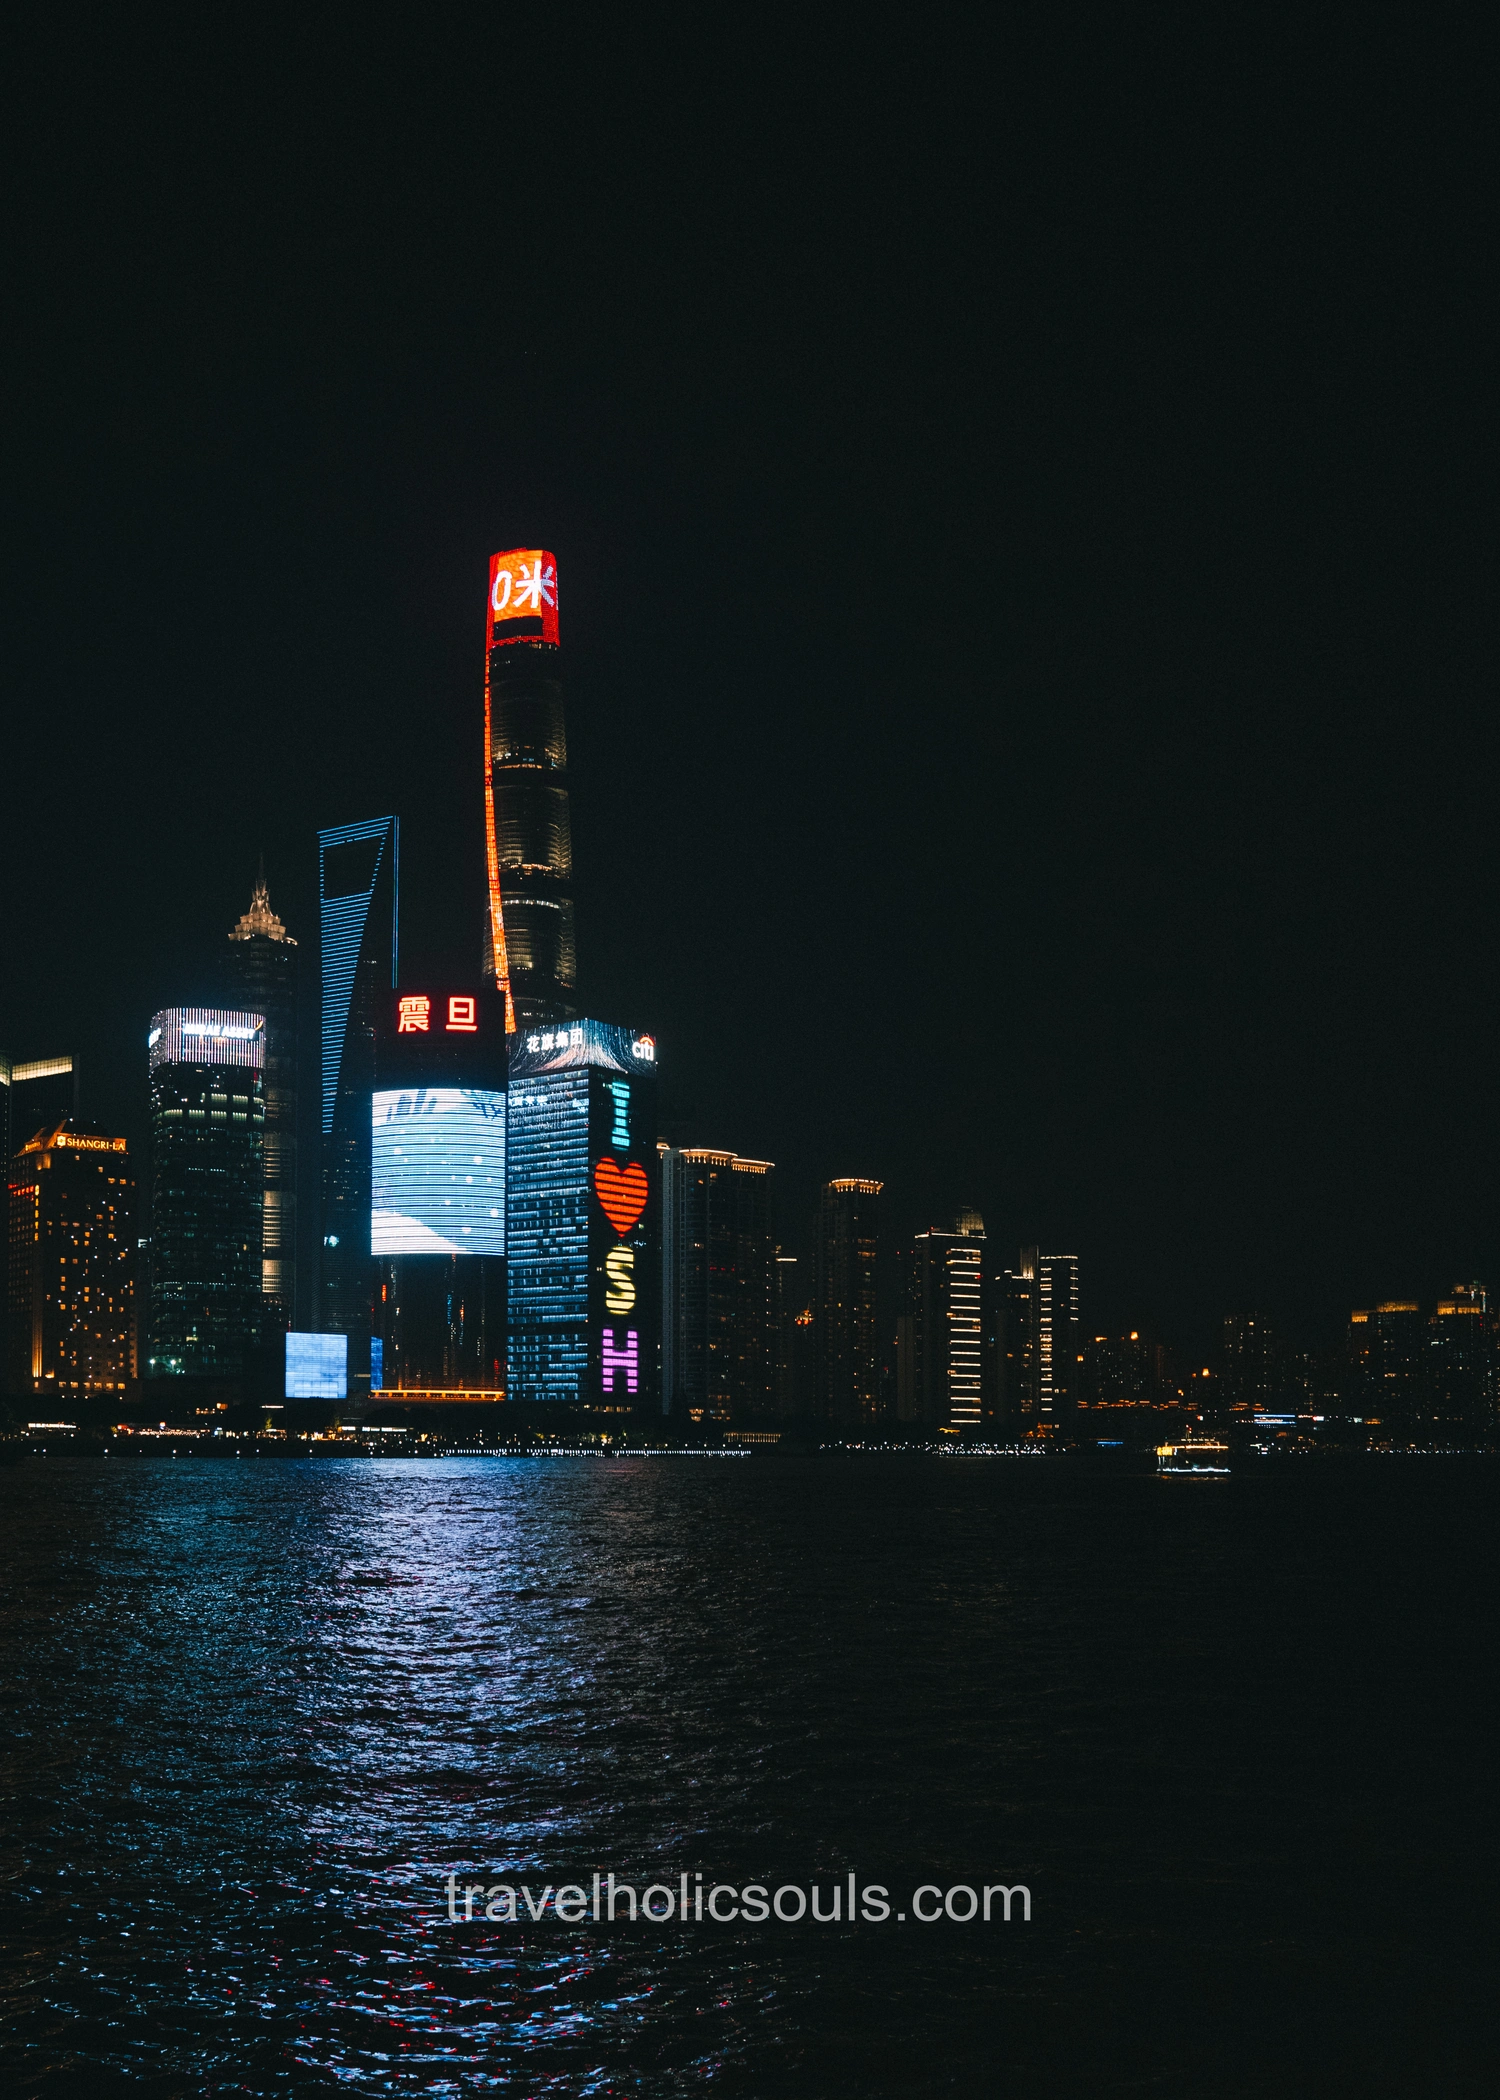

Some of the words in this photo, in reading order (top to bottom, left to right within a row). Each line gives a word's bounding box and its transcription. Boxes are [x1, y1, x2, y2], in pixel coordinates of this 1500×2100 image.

[398, 996, 477, 1032] 震旦
[526, 1028, 583, 1053] 花旗集团
[632, 1035, 655, 1061] citi
[67, 1138, 125, 1151] SHANGRI-LA
